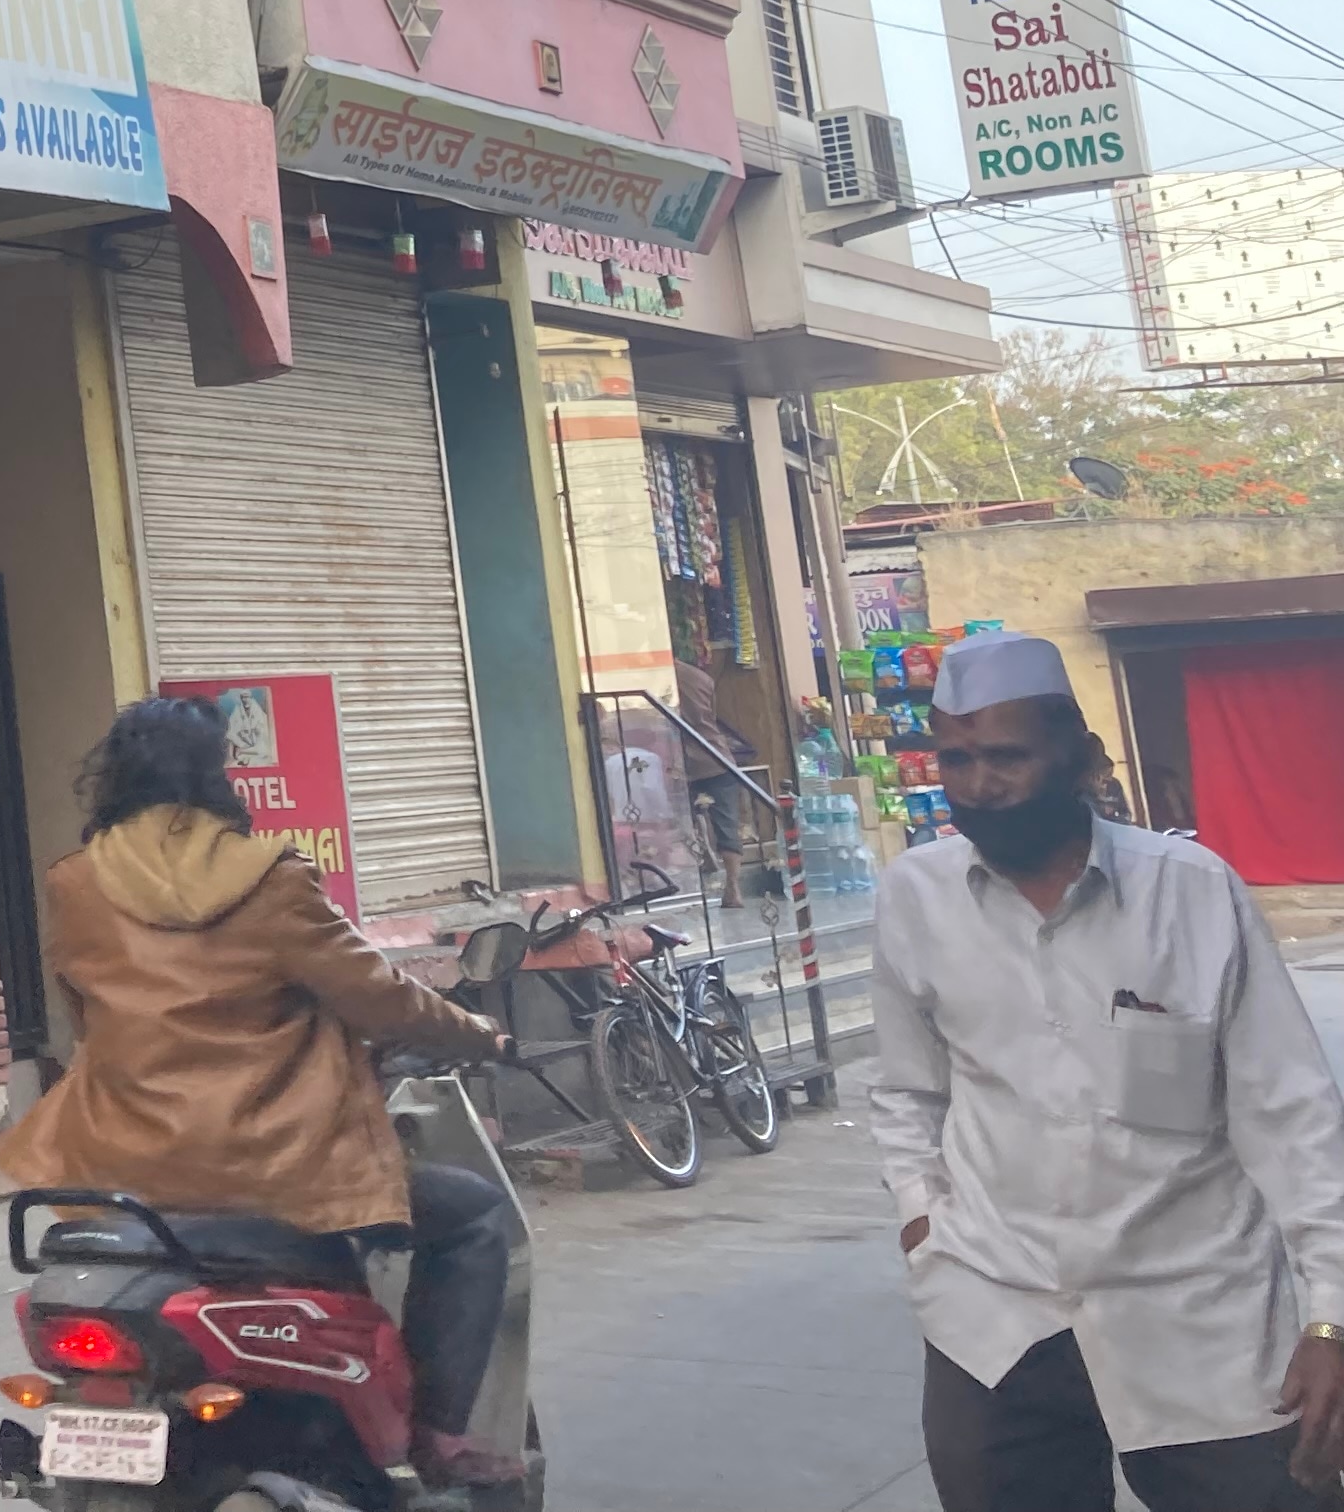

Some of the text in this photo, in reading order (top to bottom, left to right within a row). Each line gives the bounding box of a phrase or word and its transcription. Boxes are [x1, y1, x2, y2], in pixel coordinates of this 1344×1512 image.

[991, 3, 1069, 51] Sai
[962, 48, 1117, 108] Shatabdi
[15, 107, 143, 174] AVAILABLE
[331, 96, 475, 170] साईराज
[1027, 113, 1071, 133] Non
[1080, 103, 1119, 126] A/C
[342, 153, 357, 164] All
[359, 156, 389, 172] Types
[391, 163, 404, 174] Of
[978, 131, 1125, 180] ROOMS
[234, 776, 297, 810] OTEL
[239, 1324, 300, 1342] CLIQ
